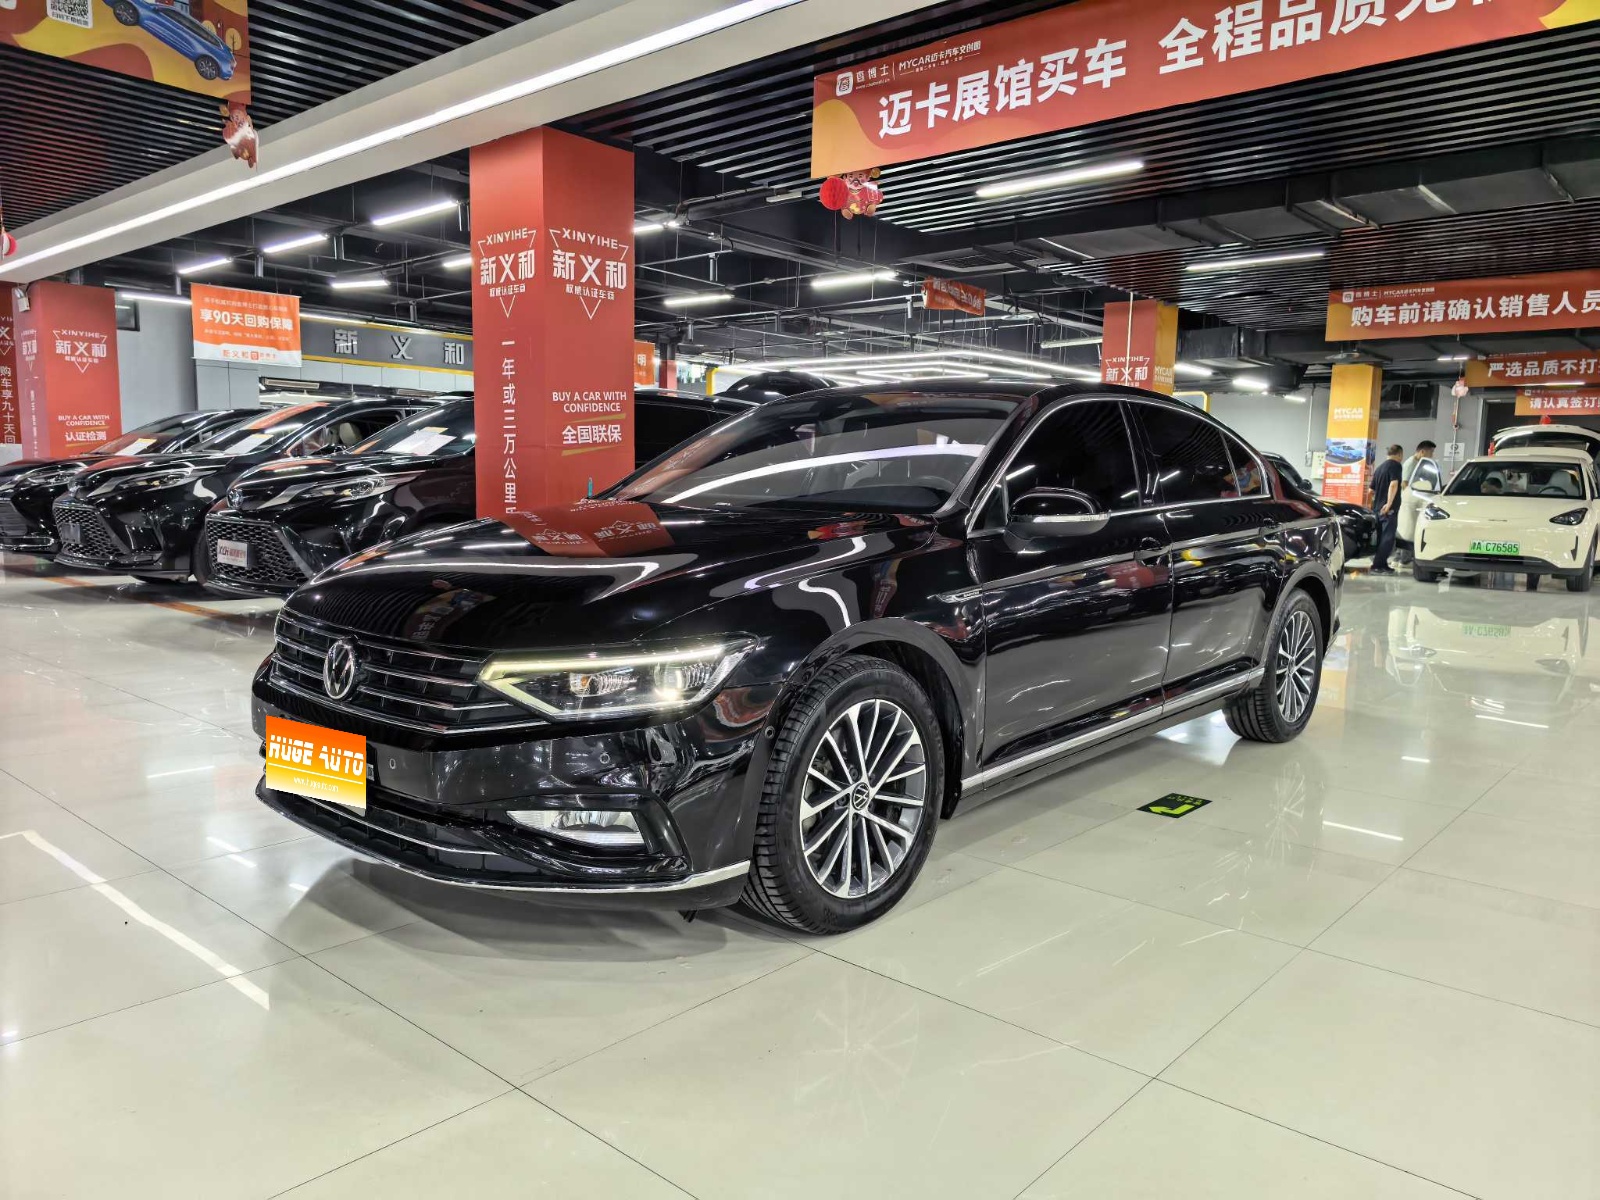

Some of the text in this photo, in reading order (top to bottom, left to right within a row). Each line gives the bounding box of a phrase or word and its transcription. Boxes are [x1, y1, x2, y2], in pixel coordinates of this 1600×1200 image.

[1159, 0, 1493, 75] 全程品质
[878, 38, 1127, 139] 迈卡展馆买车
[486, 228, 529, 246] XINYIHE
[562, 227, 618, 250] XINYIHE
[480, 249, 535, 286] 新义和
[552, 249, 627, 290] 新义和
[1351, 289, 1600, 327] 购车前请确认销售人员
[200, 308, 294, 331] 享90天回购保障
[56, 340, 107, 358] 新义和
[334, 329, 465, 365] 新义和
[1106, 366, 1148, 382] 新义和
[1488, 358, 1600, 377] 严选品质不打
[552, 391, 627, 402] BUY A CAR WITH
[1530, 396, 1600, 409] 请认真签订
[563, 402, 621, 413] CONFIDENCE
[65, 430, 107, 442] 认证检测
[562, 424, 622, 444] 全国联保
